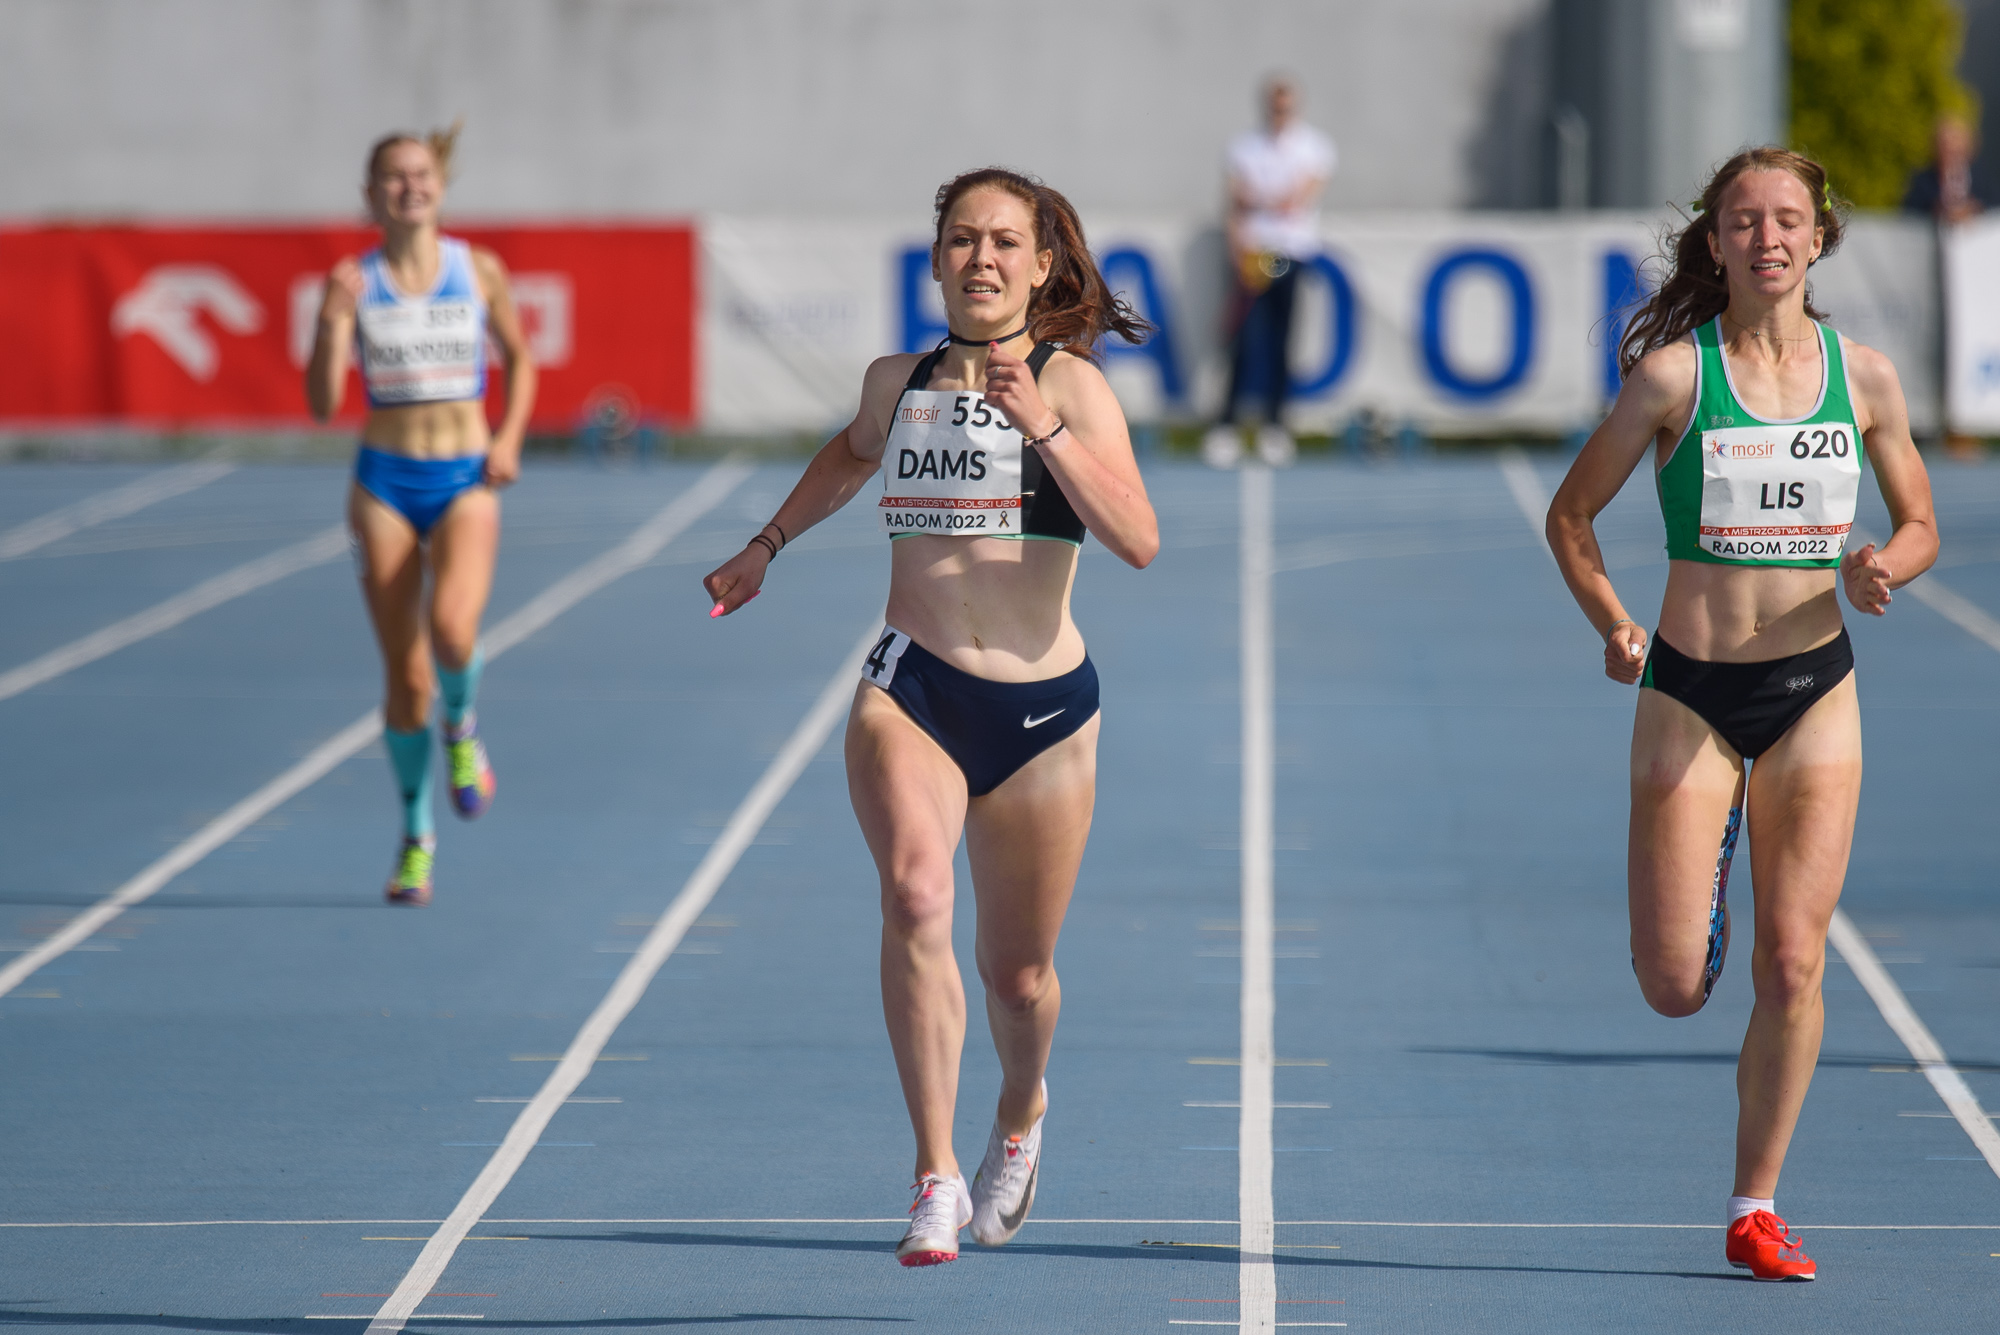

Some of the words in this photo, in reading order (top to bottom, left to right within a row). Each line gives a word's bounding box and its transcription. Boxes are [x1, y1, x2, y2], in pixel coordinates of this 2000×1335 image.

[901, 405, 941, 421] mosir
[1732, 440, 1775, 457] mosir
[1790, 430, 1849, 459] 620
[897, 449, 986, 481] DAMS
[898, 499, 956, 508] MISTRZOSTWA
[957, 499, 994, 508] POLSKI
[995, 499, 1017, 508] U20
[1760, 482, 1805, 510] LIS
[885, 512, 942, 529] RADOM
[945, 514, 986, 529] 2022
[1704, 527, 1730, 536] PZLA
[1731, 526, 1800, 536] MISTRZOSTWA
[1801, 526, 1836, 535] POLSKI
[1712, 541, 1782, 555] RADOM
[1788, 540, 1828, 553] 2022
[867, 632, 897, 679] 4
